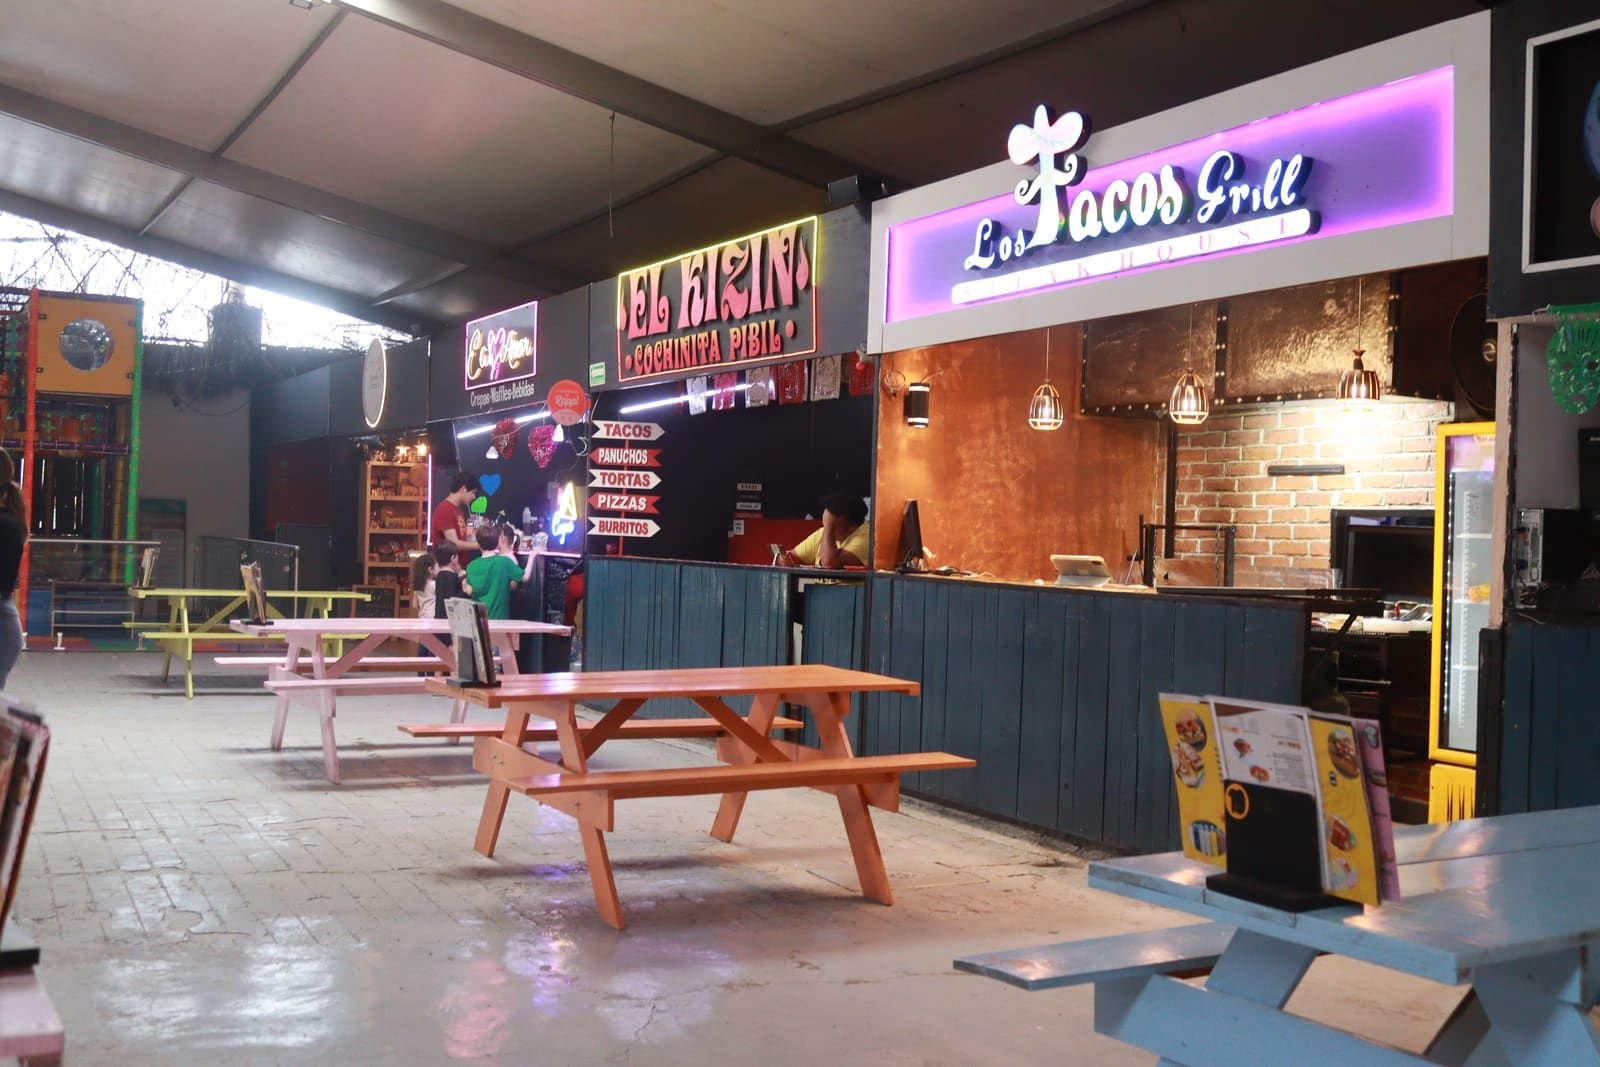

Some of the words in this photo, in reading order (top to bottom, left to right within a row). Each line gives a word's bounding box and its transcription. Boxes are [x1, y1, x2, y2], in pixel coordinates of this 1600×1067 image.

[964, 218, 1025, 271] Los
[1008, 104, 1184, 248] Tacos
[1197, 150, 1304, 224] Grill
[627, 266, 670, 340] EL
[677, 224, 799, 329] KIZIN
[634, 330, 721, 375] COCHINITA
[728, 319, 782, 360] PIBIL
[603, 423, 652, 438] TACOS
[598, 447, 648, 465] PANUCHOS
[600, 472, 650, 487] TORTAS
[597, 495, 647, 511] PIZZAS
[598, 520, 649, 535] BURRITOS
